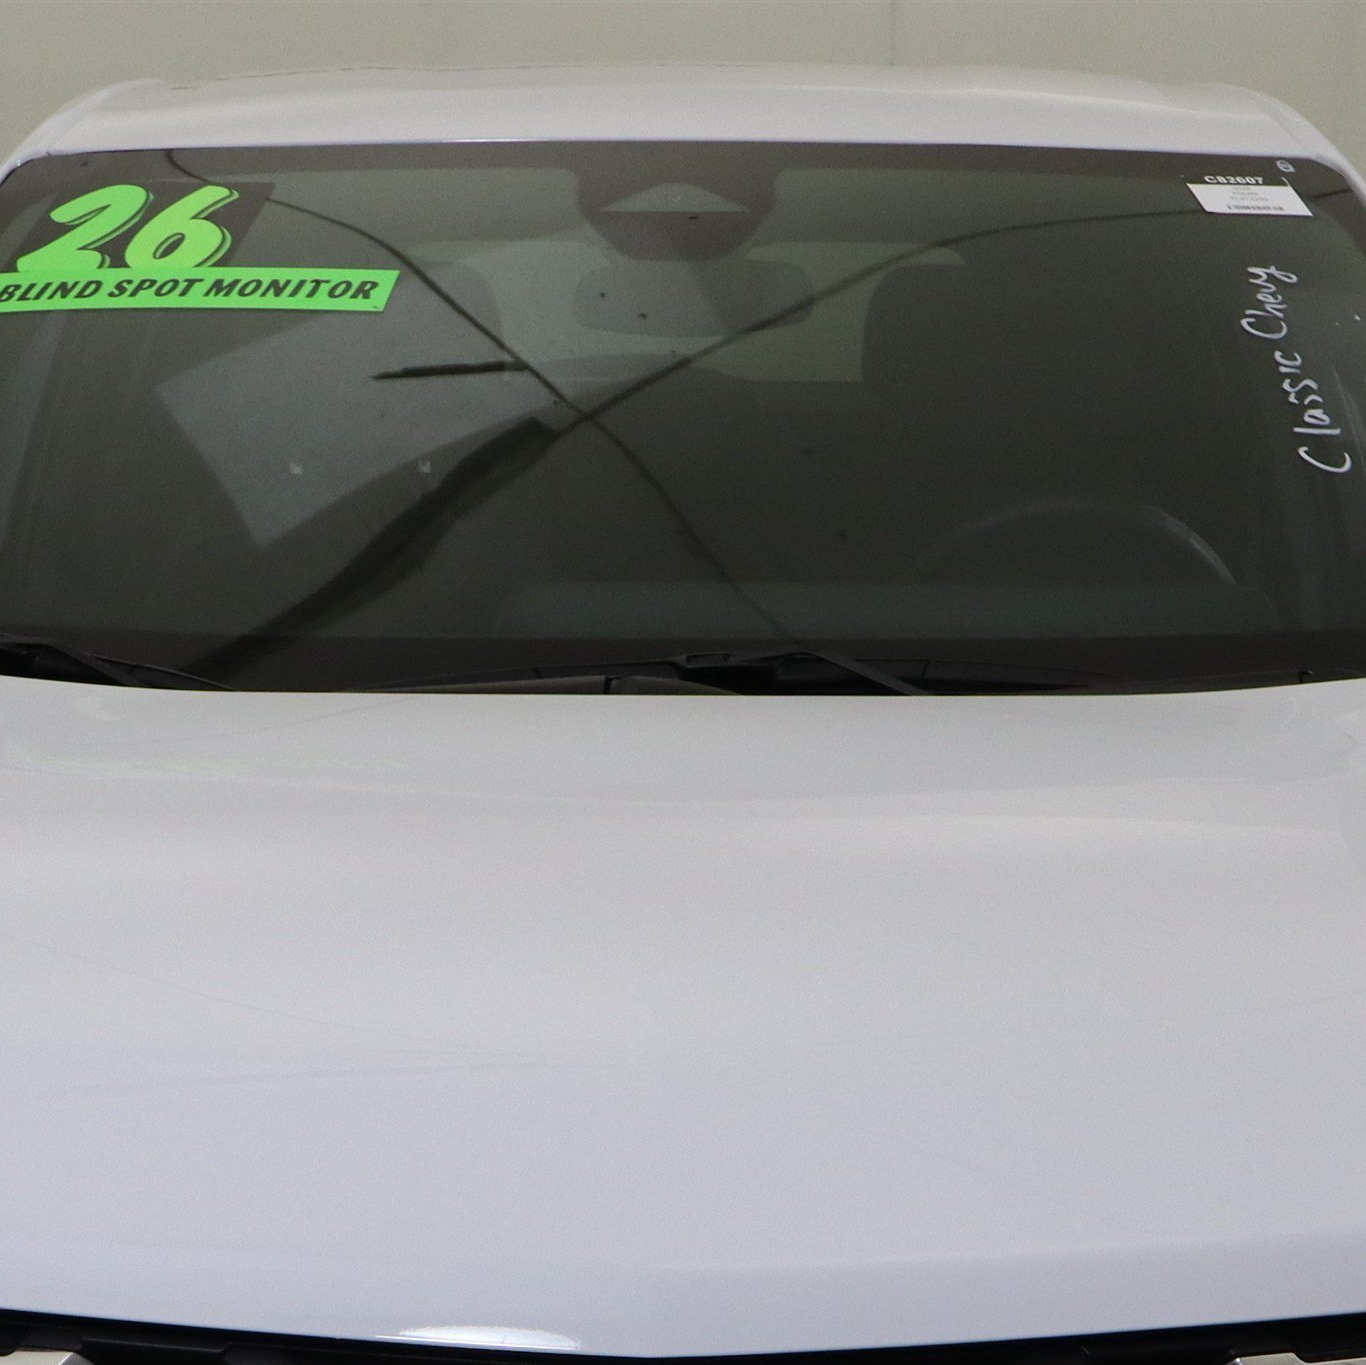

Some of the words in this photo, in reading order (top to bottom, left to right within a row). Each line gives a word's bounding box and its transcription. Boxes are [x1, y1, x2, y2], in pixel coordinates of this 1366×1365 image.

[16, 184, 239, 272] 26
[106, 278, 205, 301] SPOT
[207, 279, 381, 301] MONITOR
[1240, 264, 1298, 340] Chevy
